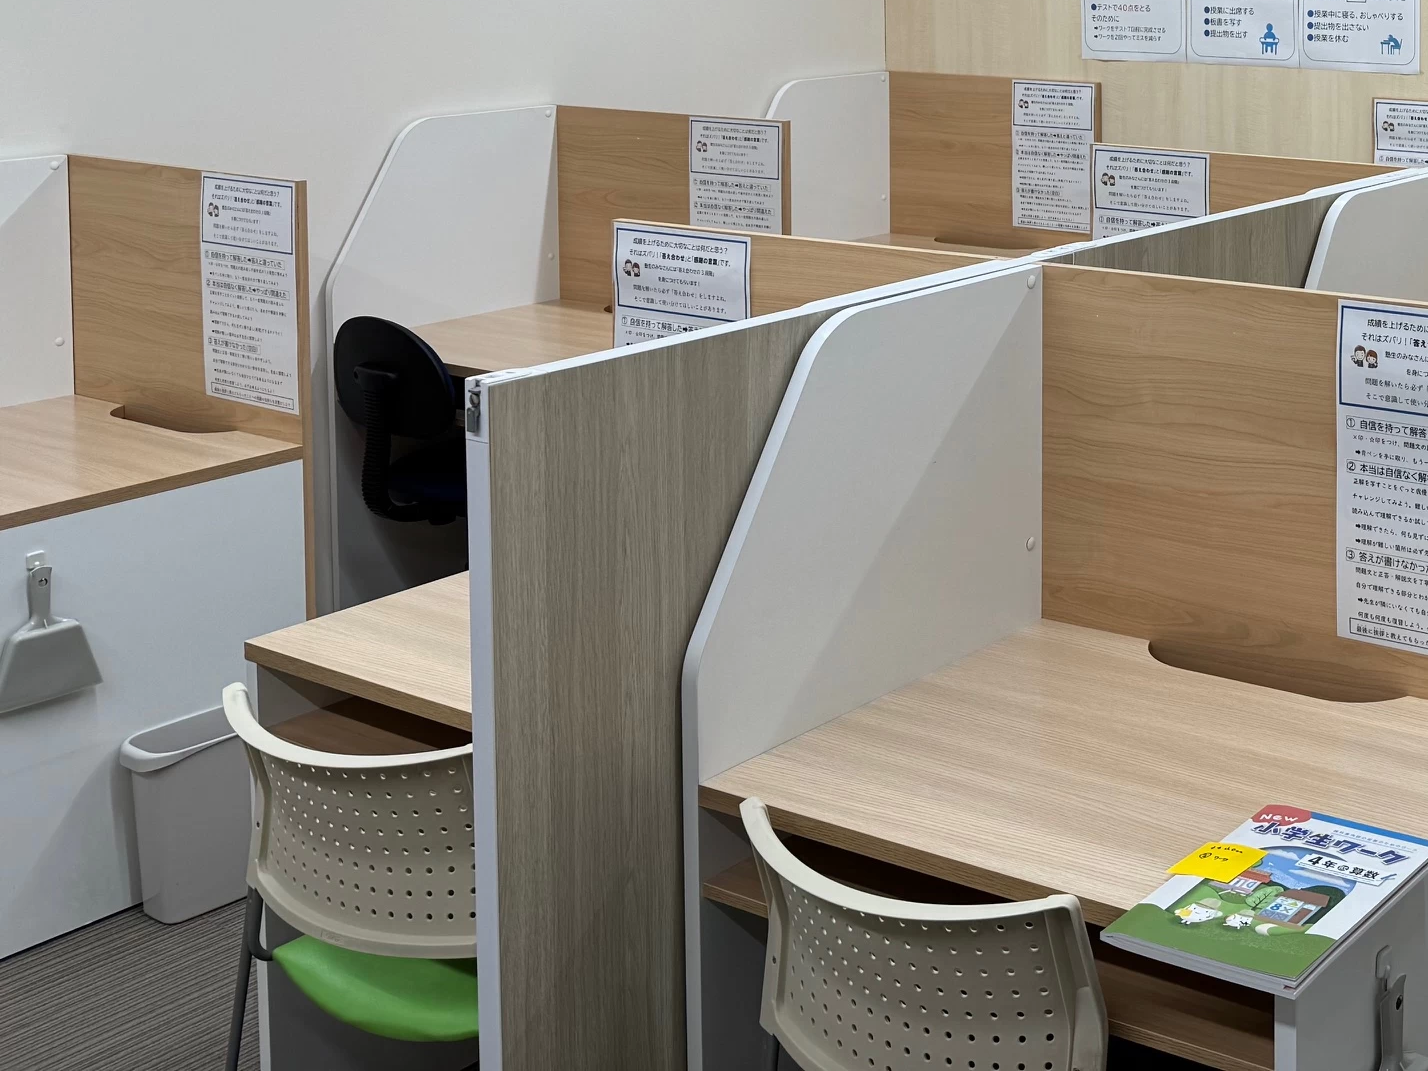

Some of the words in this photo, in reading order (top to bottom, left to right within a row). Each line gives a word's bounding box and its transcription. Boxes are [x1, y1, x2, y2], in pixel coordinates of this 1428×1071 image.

[1210, 7, 1254, 15] 授業に出席する
[1210, 18, 1242, 26] 板書を写す
[1314, 22, 1369, 31] 提出物を出さない
[1210, 30, 1247, 38] 提出物を出す
[1314, 34, 1349, 42] 授業を休む
[1253, 821, 1409, 866] 小学生ワーク
